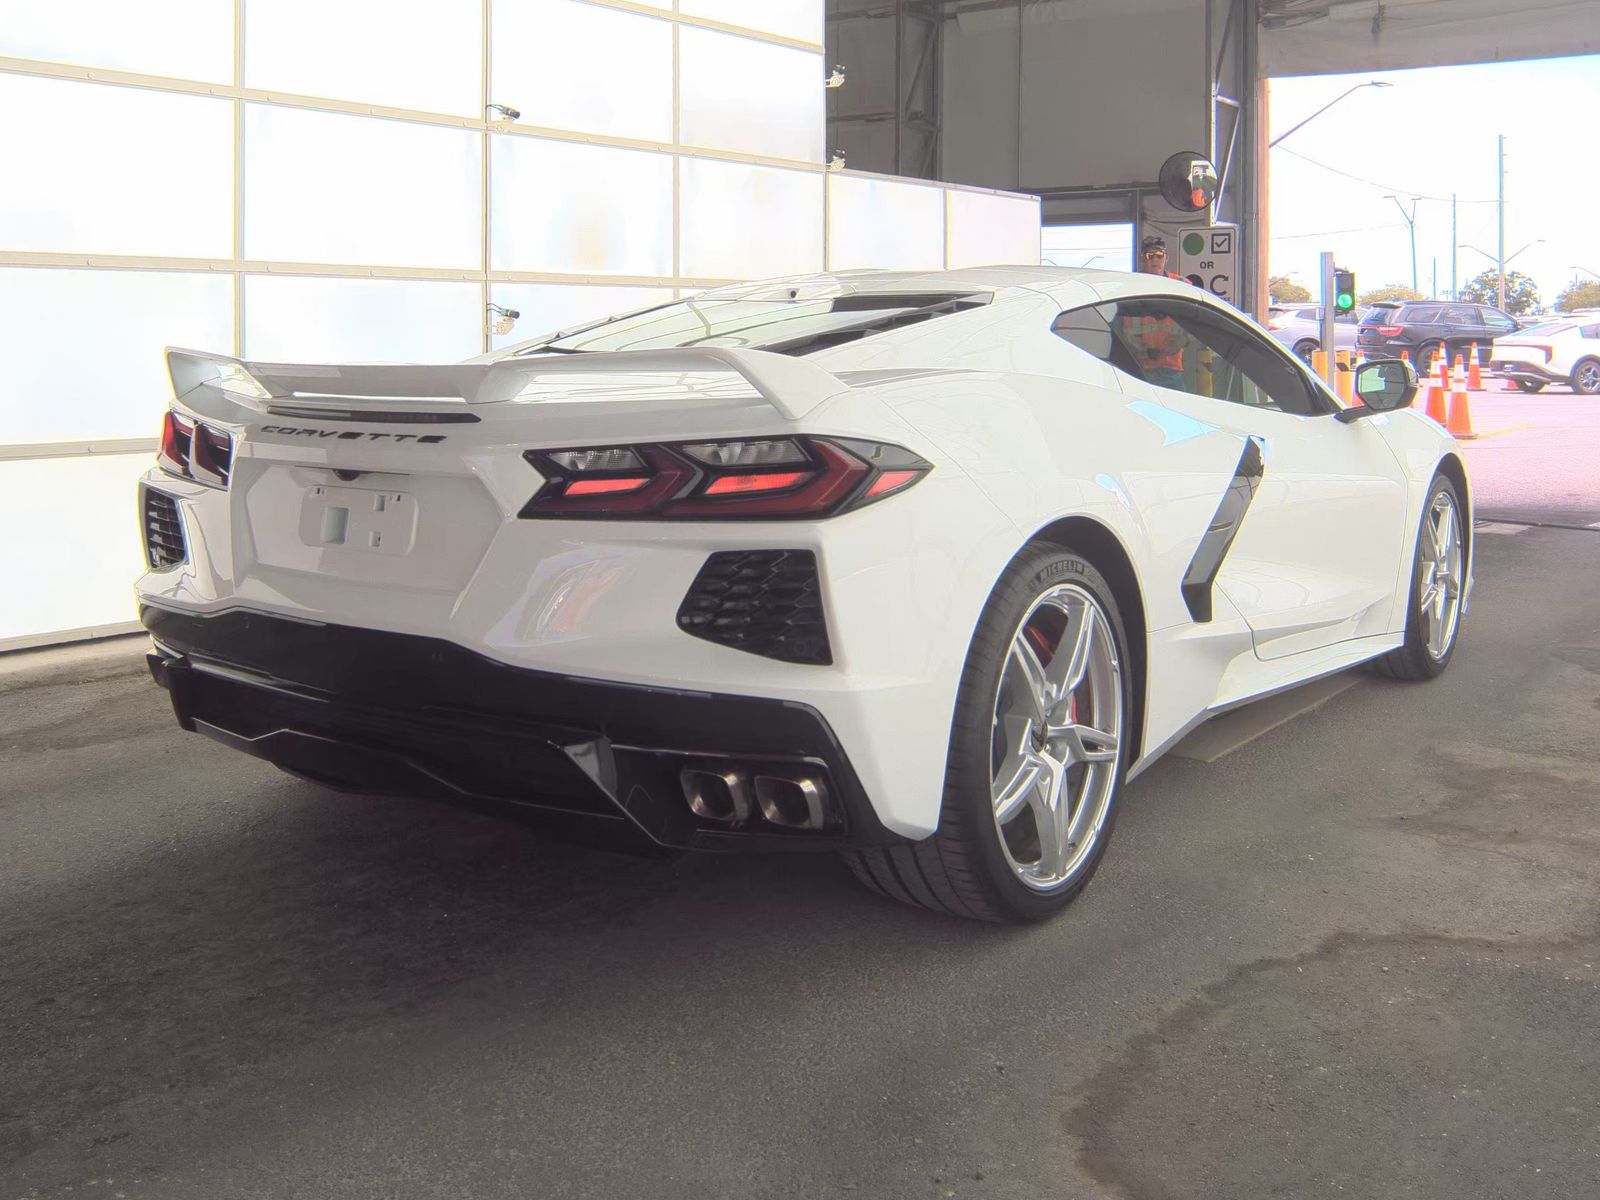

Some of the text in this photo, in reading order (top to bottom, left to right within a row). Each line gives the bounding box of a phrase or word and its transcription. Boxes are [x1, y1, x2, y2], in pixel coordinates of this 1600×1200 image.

[1200, 261, 1214, 269] OR
[261, 426, 448, 443] CORVETTE
[1039, 559, 1085, 581] MICHELIN
